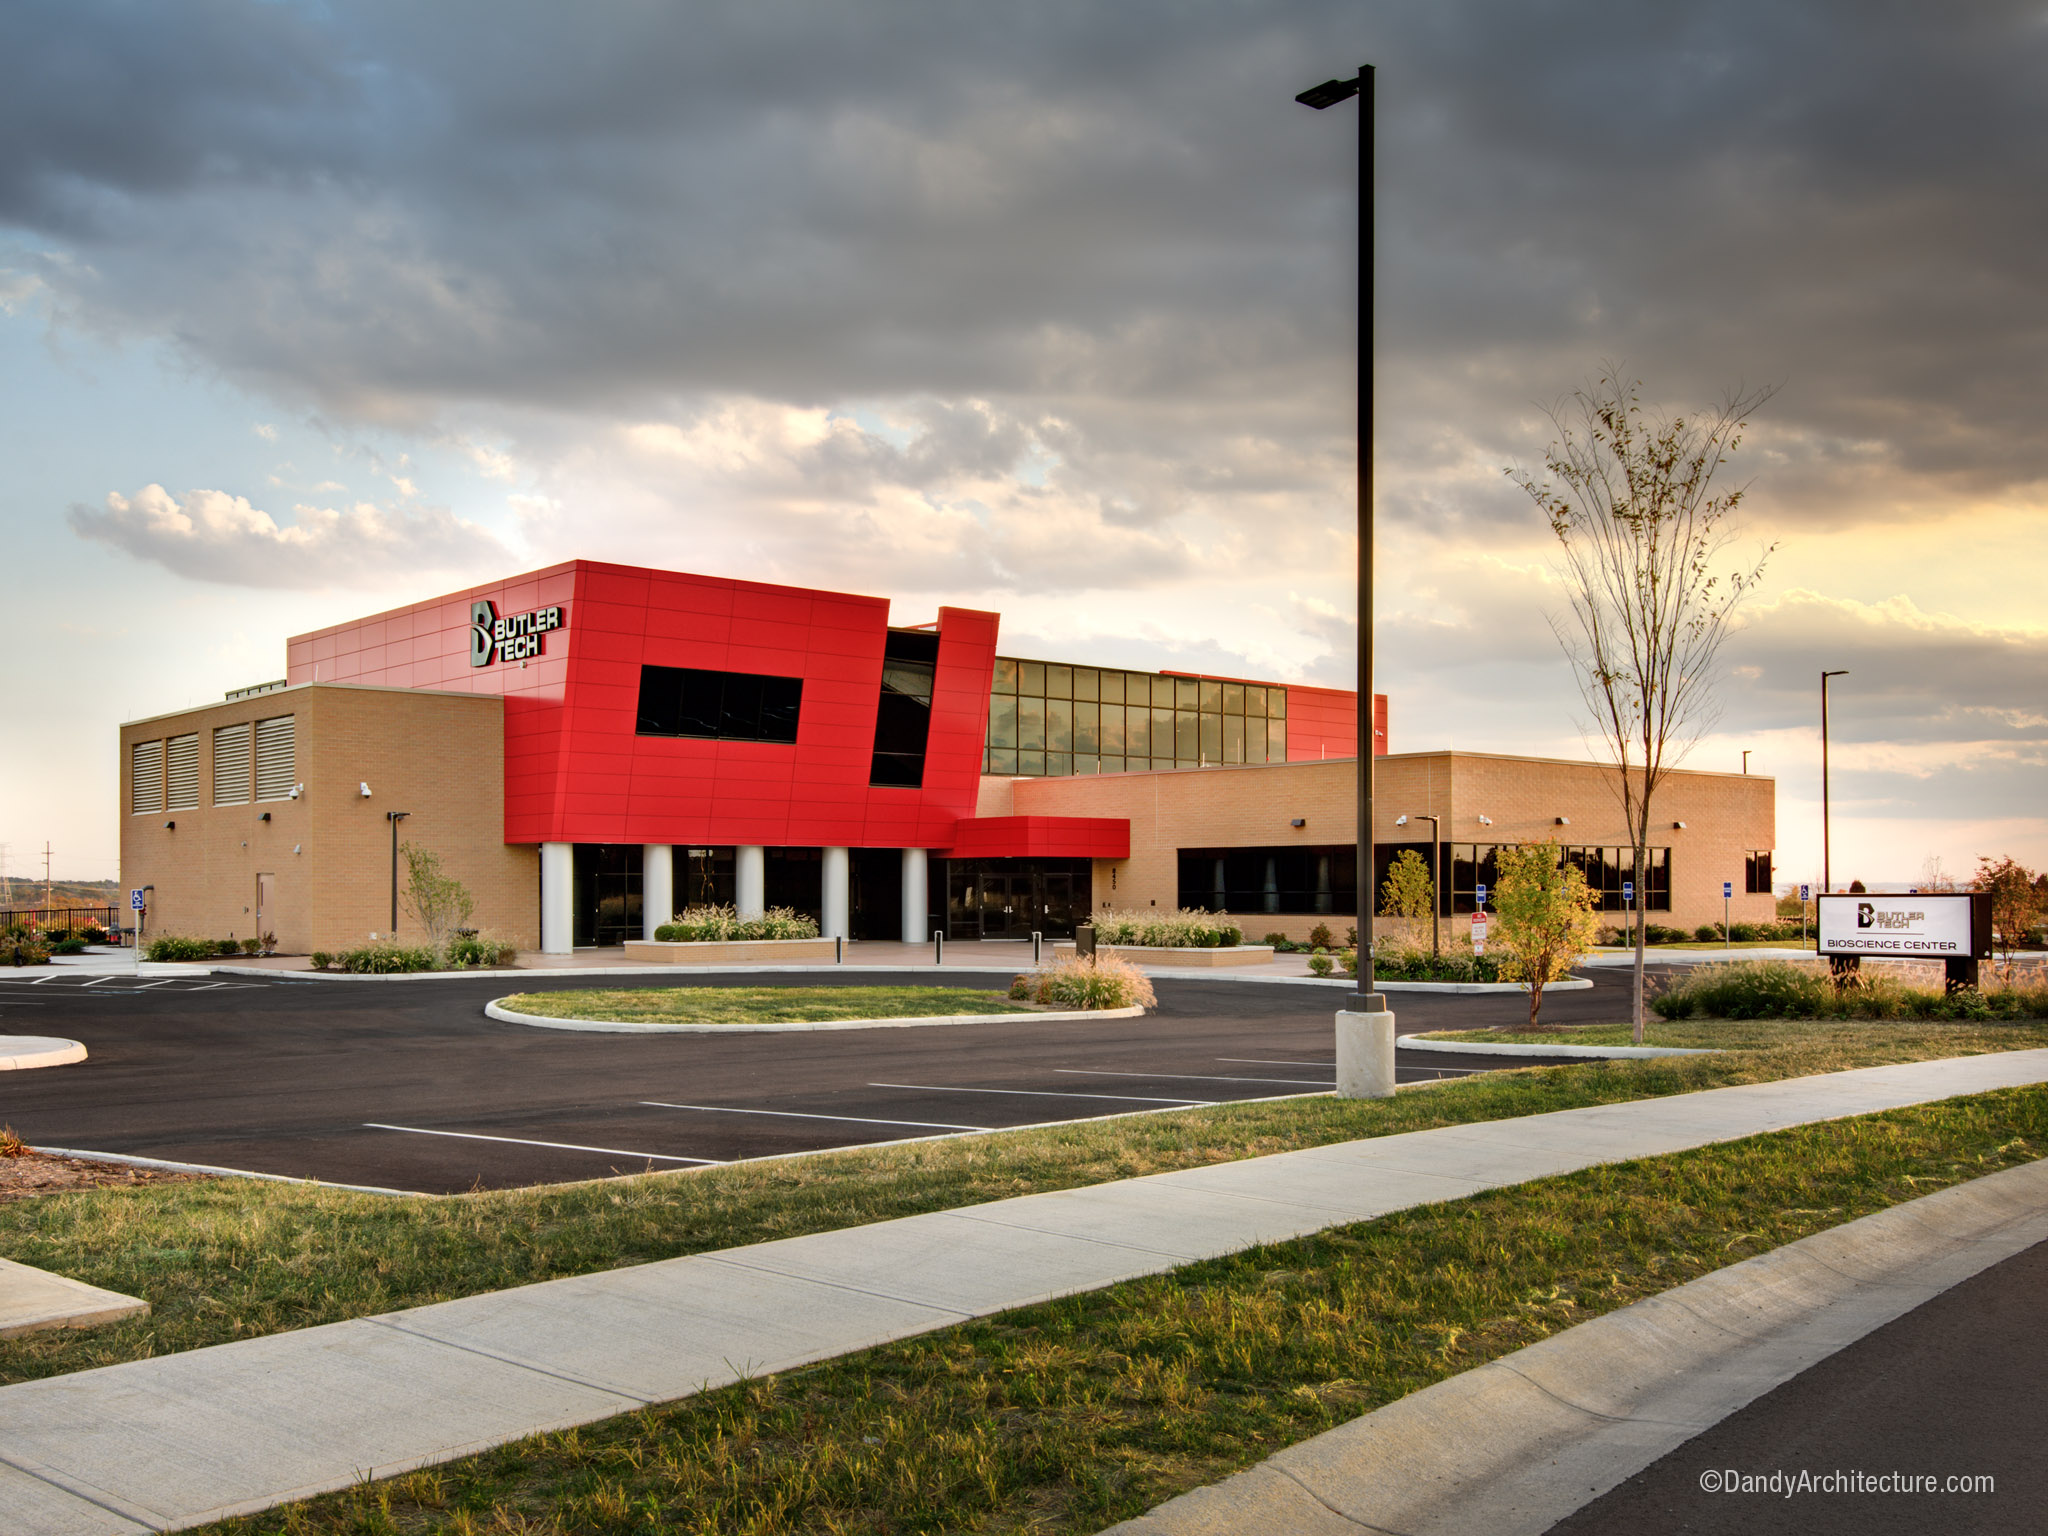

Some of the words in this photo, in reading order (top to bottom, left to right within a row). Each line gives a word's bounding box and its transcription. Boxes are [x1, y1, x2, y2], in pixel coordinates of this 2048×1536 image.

[495, 606, 561, 641] BUTLER
[495, 633, 540, 662] TECH
[1877, 912, 1924, 921] BUTLER
[1877, 920, 1909, 929] TECH
[1827, 939, 1900, 949] BIOSCIENCE
[1904, 941, 1957, 950] CENTER
